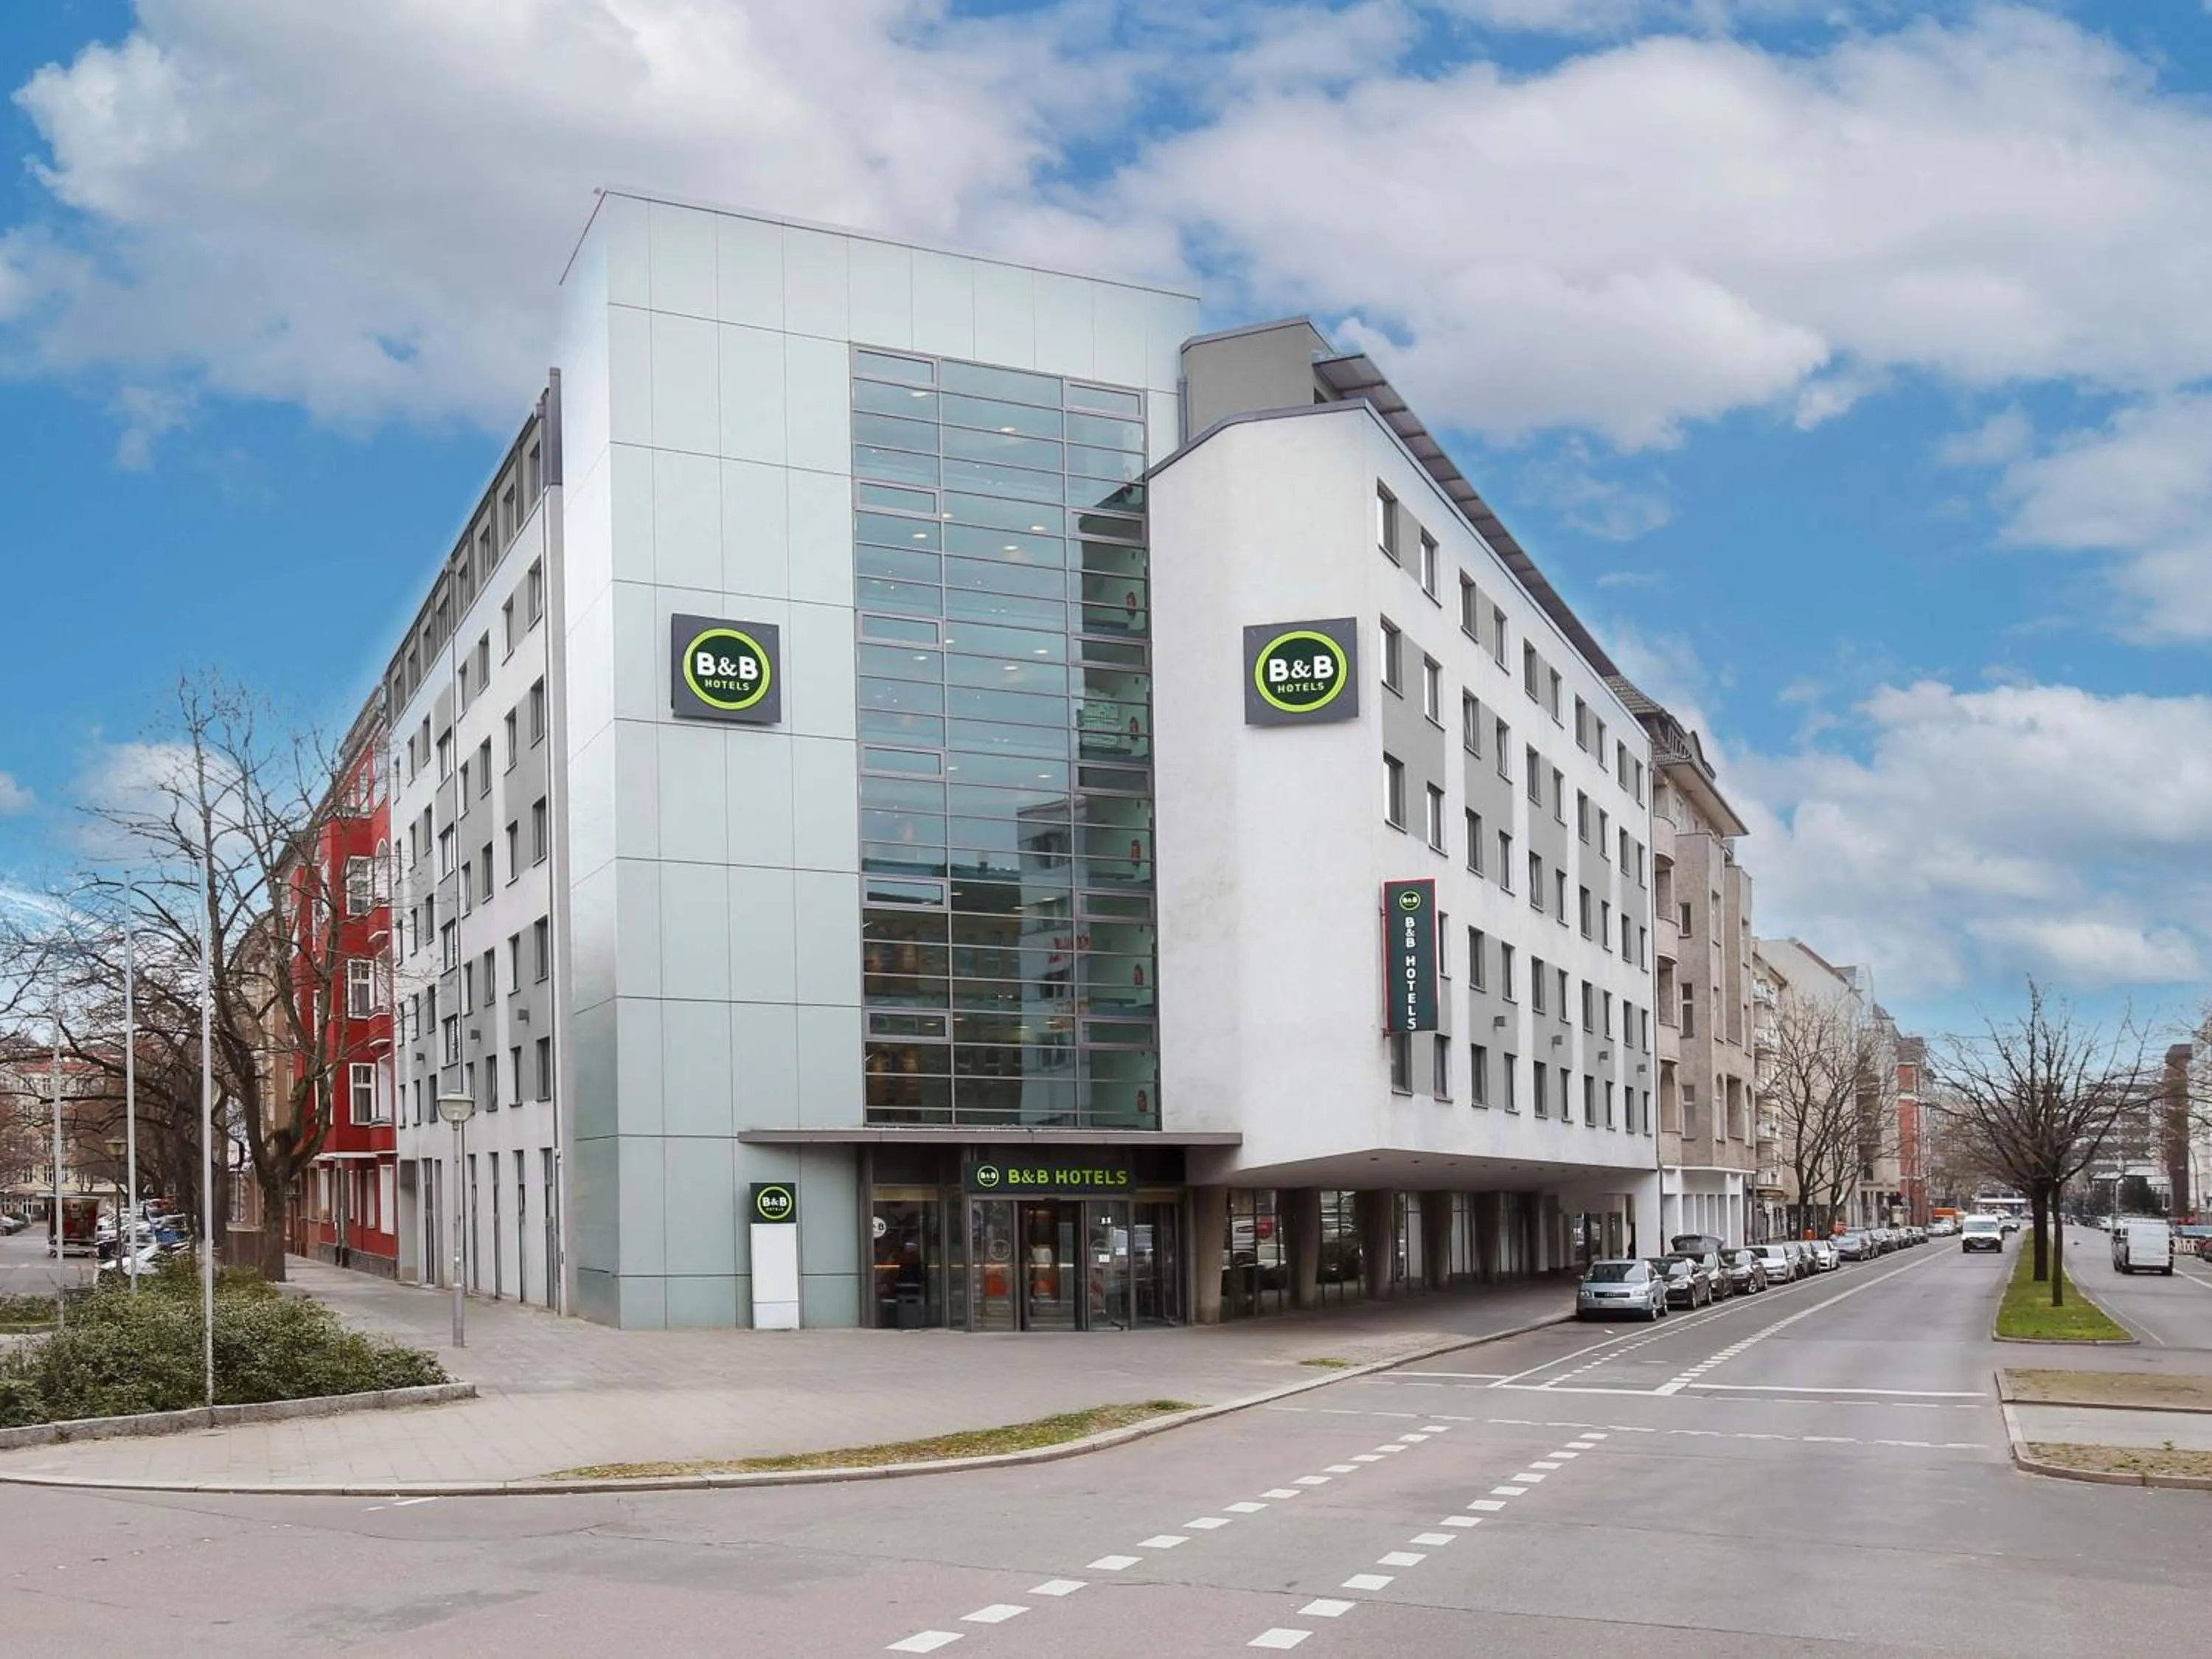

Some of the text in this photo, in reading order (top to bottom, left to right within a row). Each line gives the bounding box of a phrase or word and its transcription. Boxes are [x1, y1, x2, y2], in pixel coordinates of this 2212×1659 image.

[697, 652, 758, 680] B&B
[1269, 655, 1334, 682] B&B
[704, 679, 750, 691] HOTELS
[1277, 682, 1325, 693] HOTELS
[1404, 917, 1416, 948] B&B
[1405, 956, 1416, 1030] HOTELS
[1008, 1169, 1127, 1185] B&B HOTELS
[762, 1197, 787, 1207] B&B
